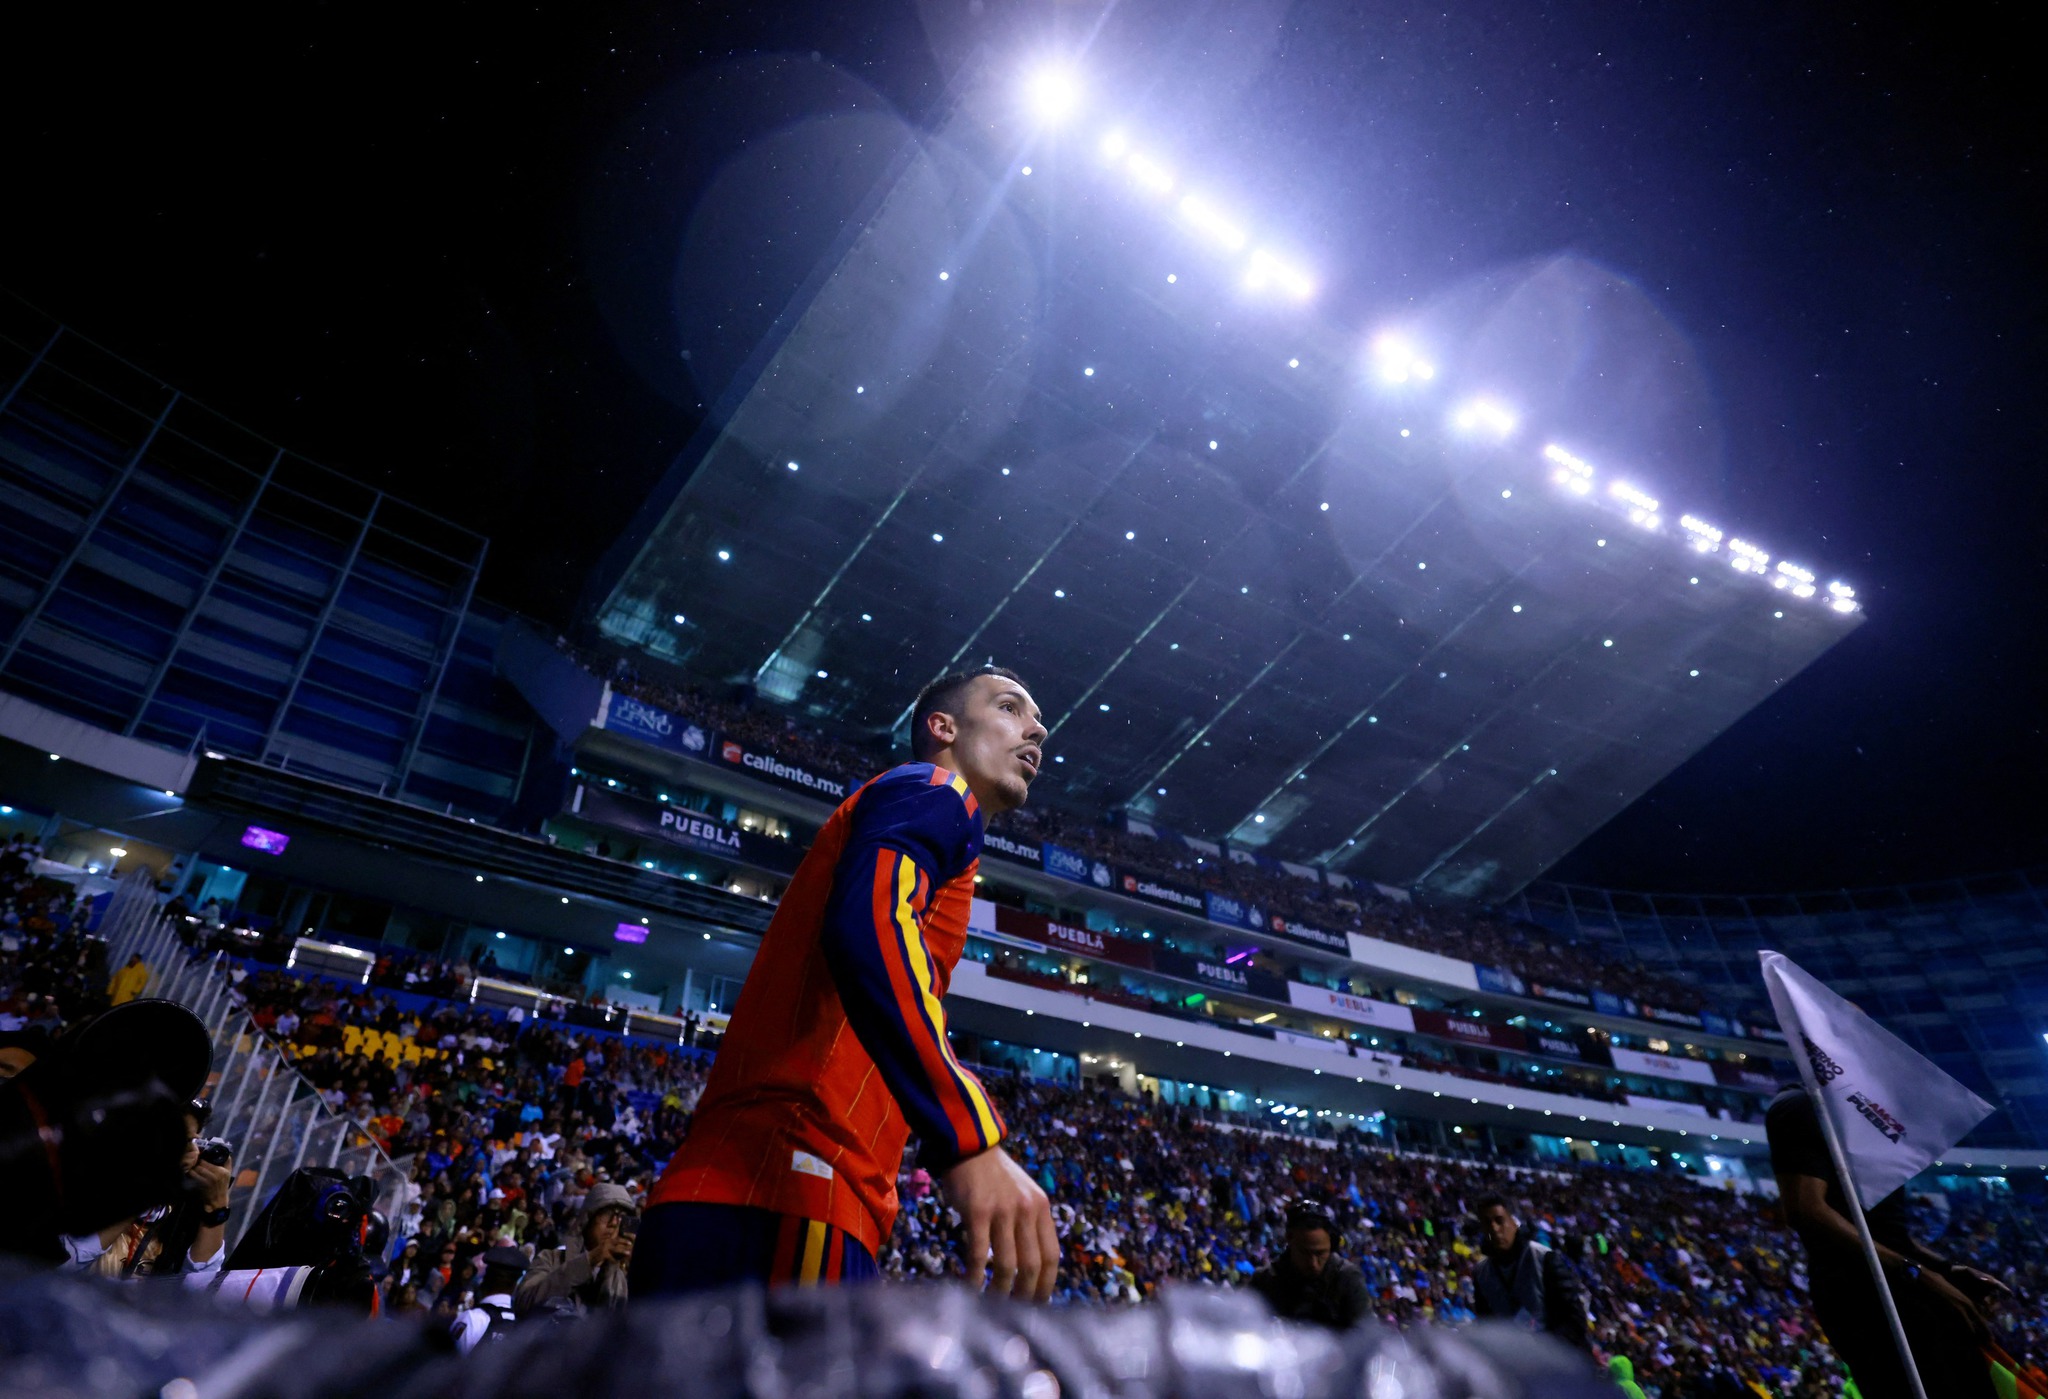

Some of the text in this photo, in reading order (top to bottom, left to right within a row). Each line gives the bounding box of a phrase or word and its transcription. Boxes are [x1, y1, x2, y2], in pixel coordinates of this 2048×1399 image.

[743, 752, 844, 797] caliente.mx
[661, 811, 741, 848] PUEBLA
[984, 834, 1040, 861] ente.mx
[1137, 882, 1202, 909] caliente.mx
[1048, 923, 1104, 949] PUEBLA
[1197, 962, 1248, 985] PUEBLA
[1446, 1019, 1491, 1038] PUEBLA
[1847, 1095, 1900, 1145] PUEBLA
